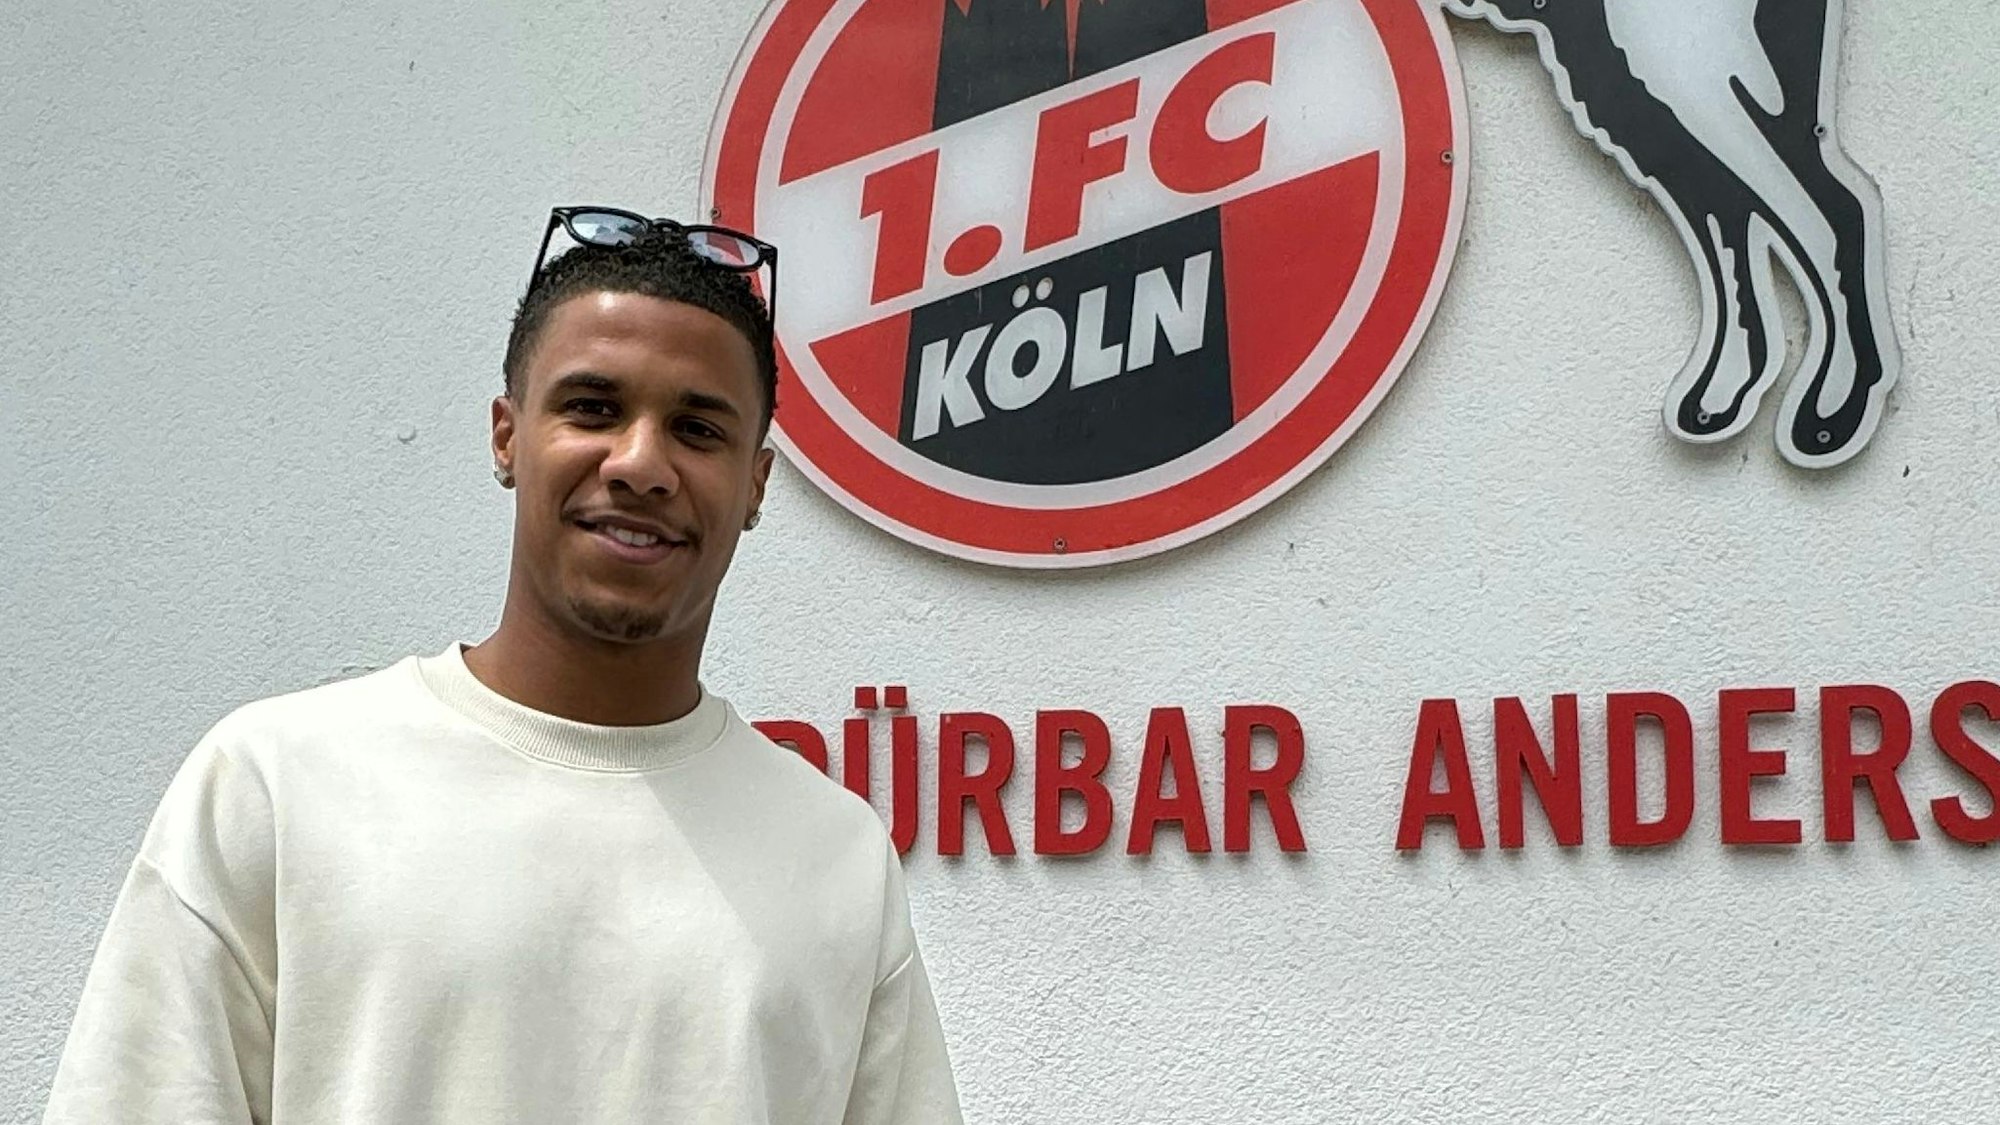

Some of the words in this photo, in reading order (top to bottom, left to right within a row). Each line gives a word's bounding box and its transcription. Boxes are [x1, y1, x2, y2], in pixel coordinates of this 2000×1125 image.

[912, 252, 1211, 441] KÖLN
[750, 685, 1308, 856] ÜRBAR
[1395, 680, 2000, 850] ANDERS
